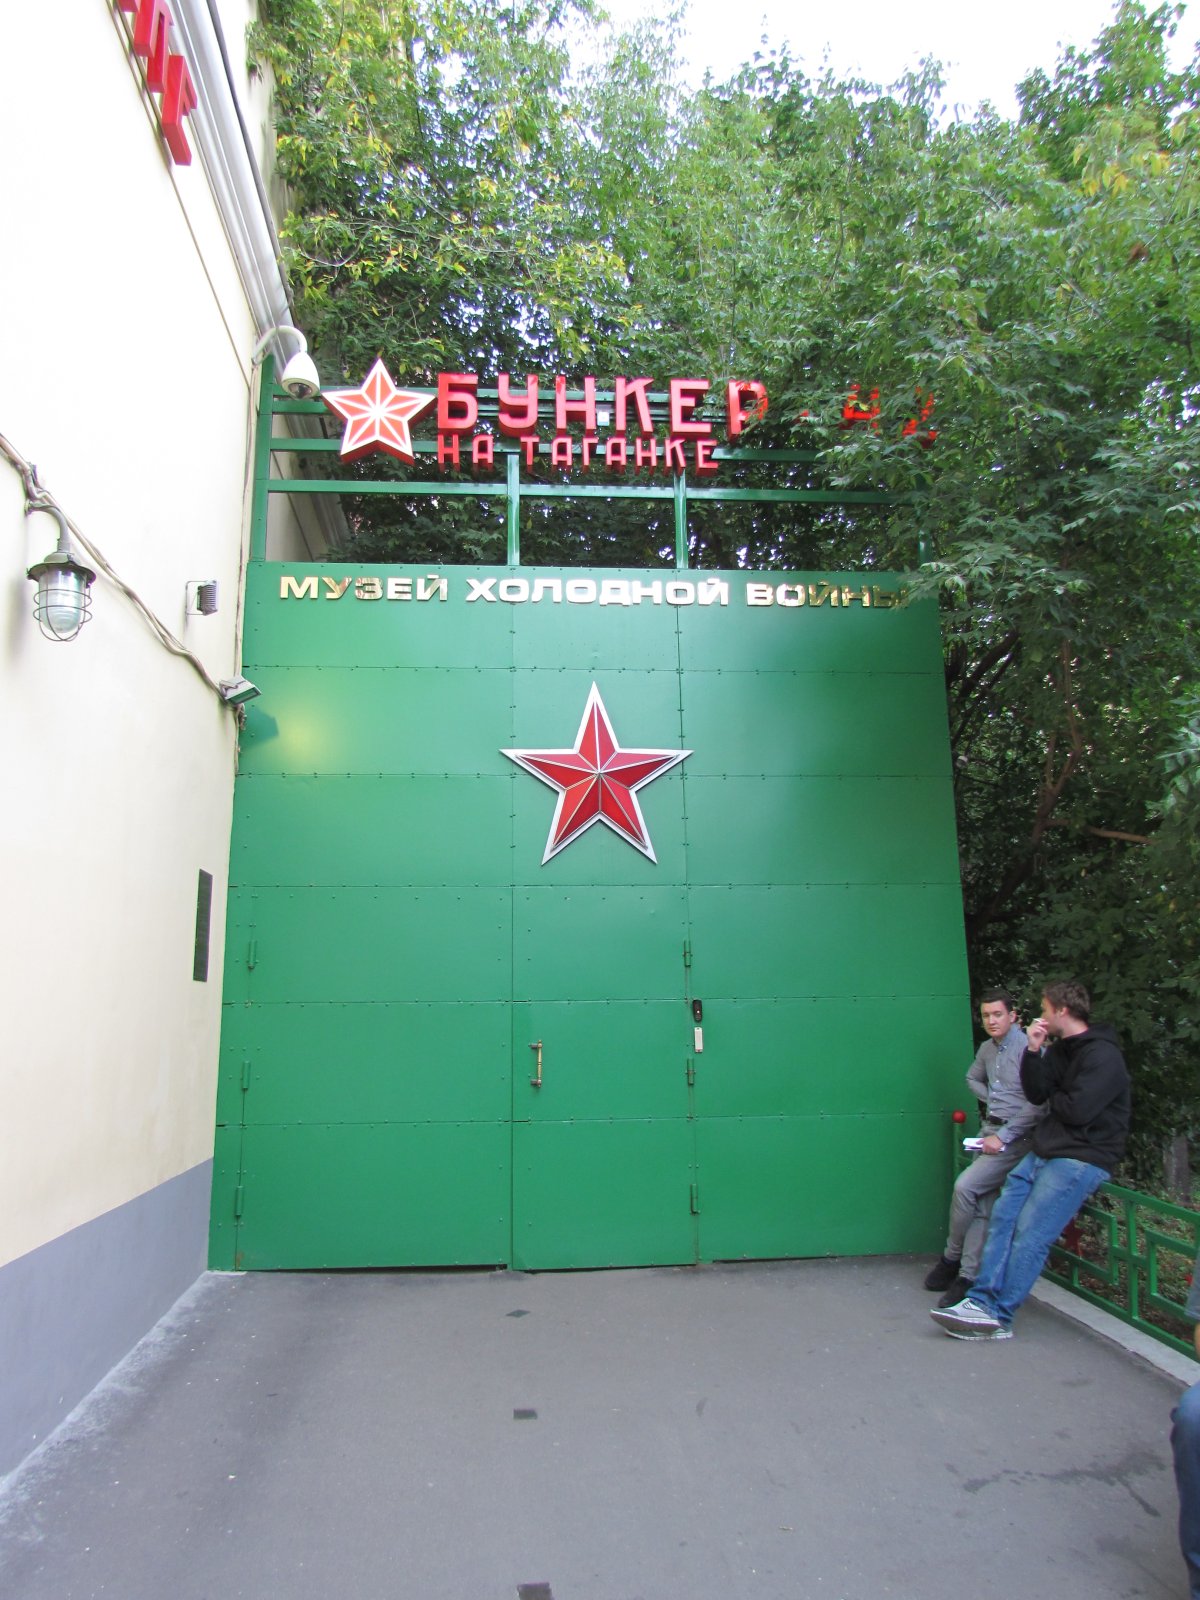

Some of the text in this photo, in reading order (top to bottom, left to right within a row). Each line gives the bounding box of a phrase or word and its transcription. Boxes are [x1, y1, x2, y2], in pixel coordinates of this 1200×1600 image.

[437, 372, 769, 438] БУНКЕР
[437, 434, 720, 473] НА ТАГАНКЕ
[279, 574, 908, 608] МУЗЕЙ ХОЛОДНОЙ ВОЙНЫ
